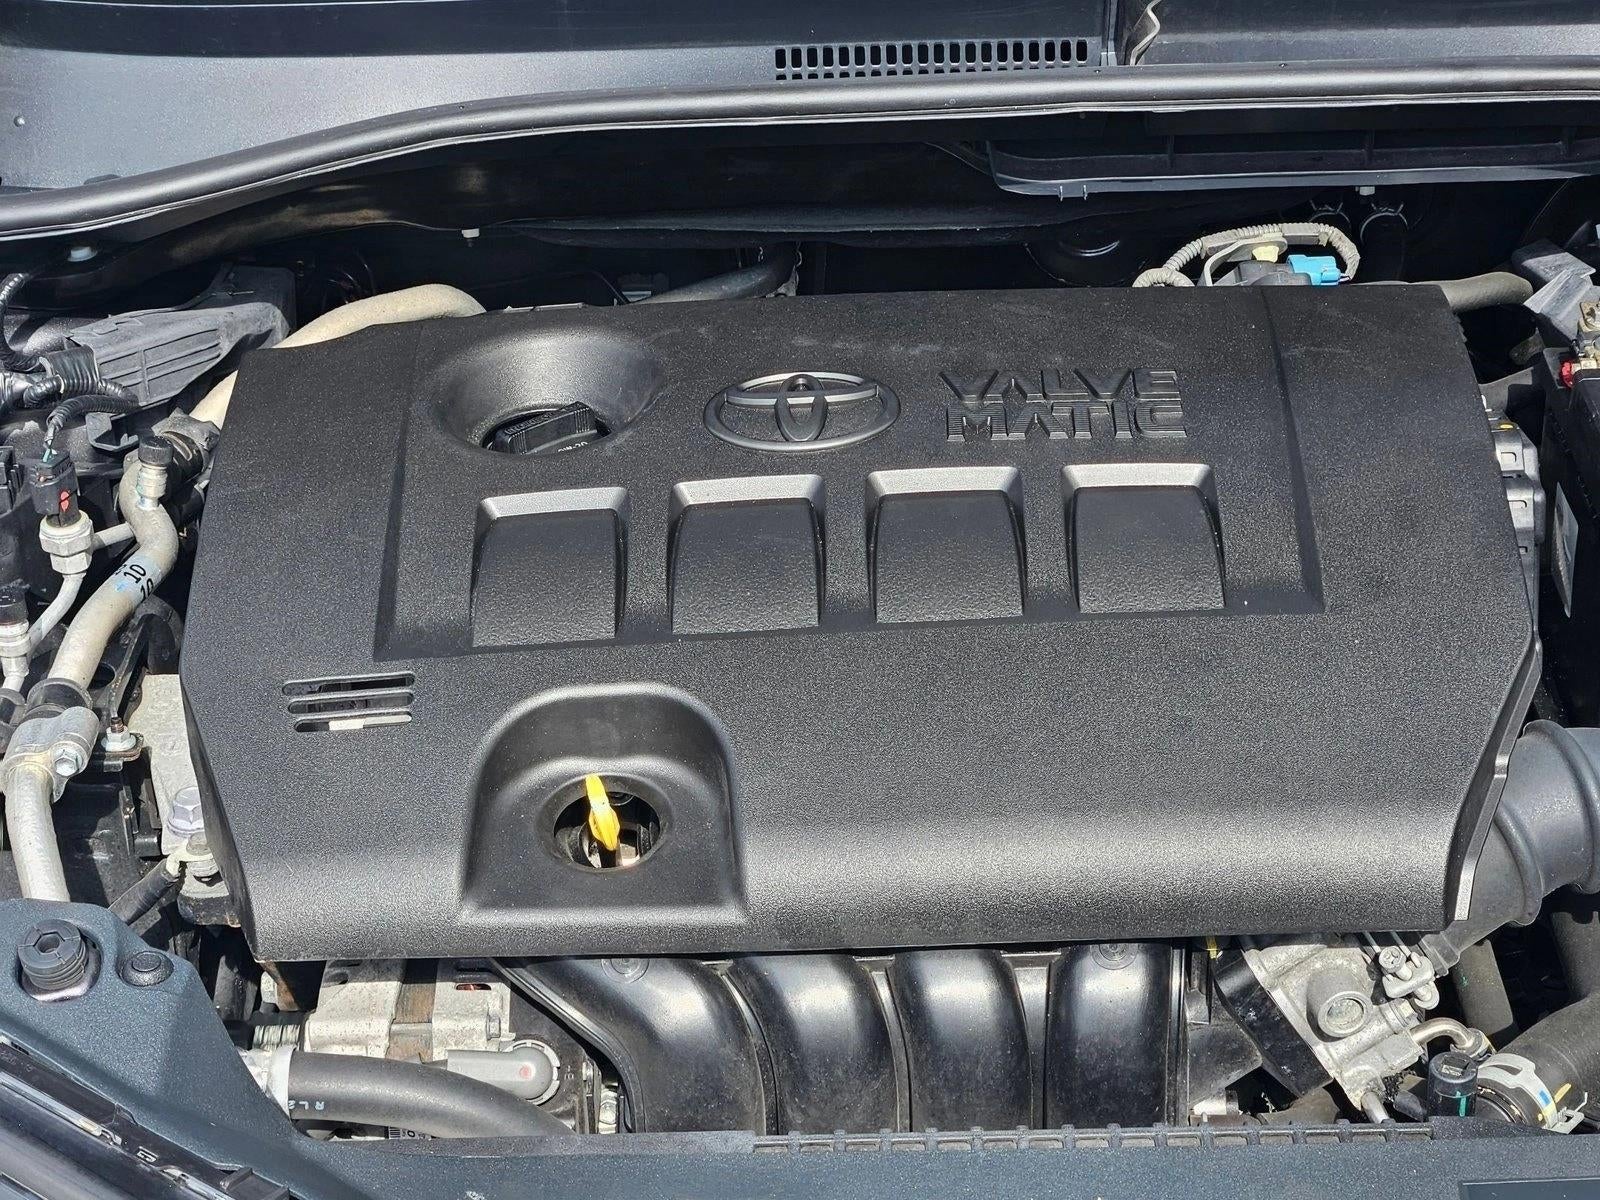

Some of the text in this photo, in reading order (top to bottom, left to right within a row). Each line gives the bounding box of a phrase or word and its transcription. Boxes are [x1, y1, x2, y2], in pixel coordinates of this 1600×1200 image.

[939, 369, 1180, 403] VALVE
[947, 400, 1187, 441] MATIC
[124, 564, 146, 584] 10
